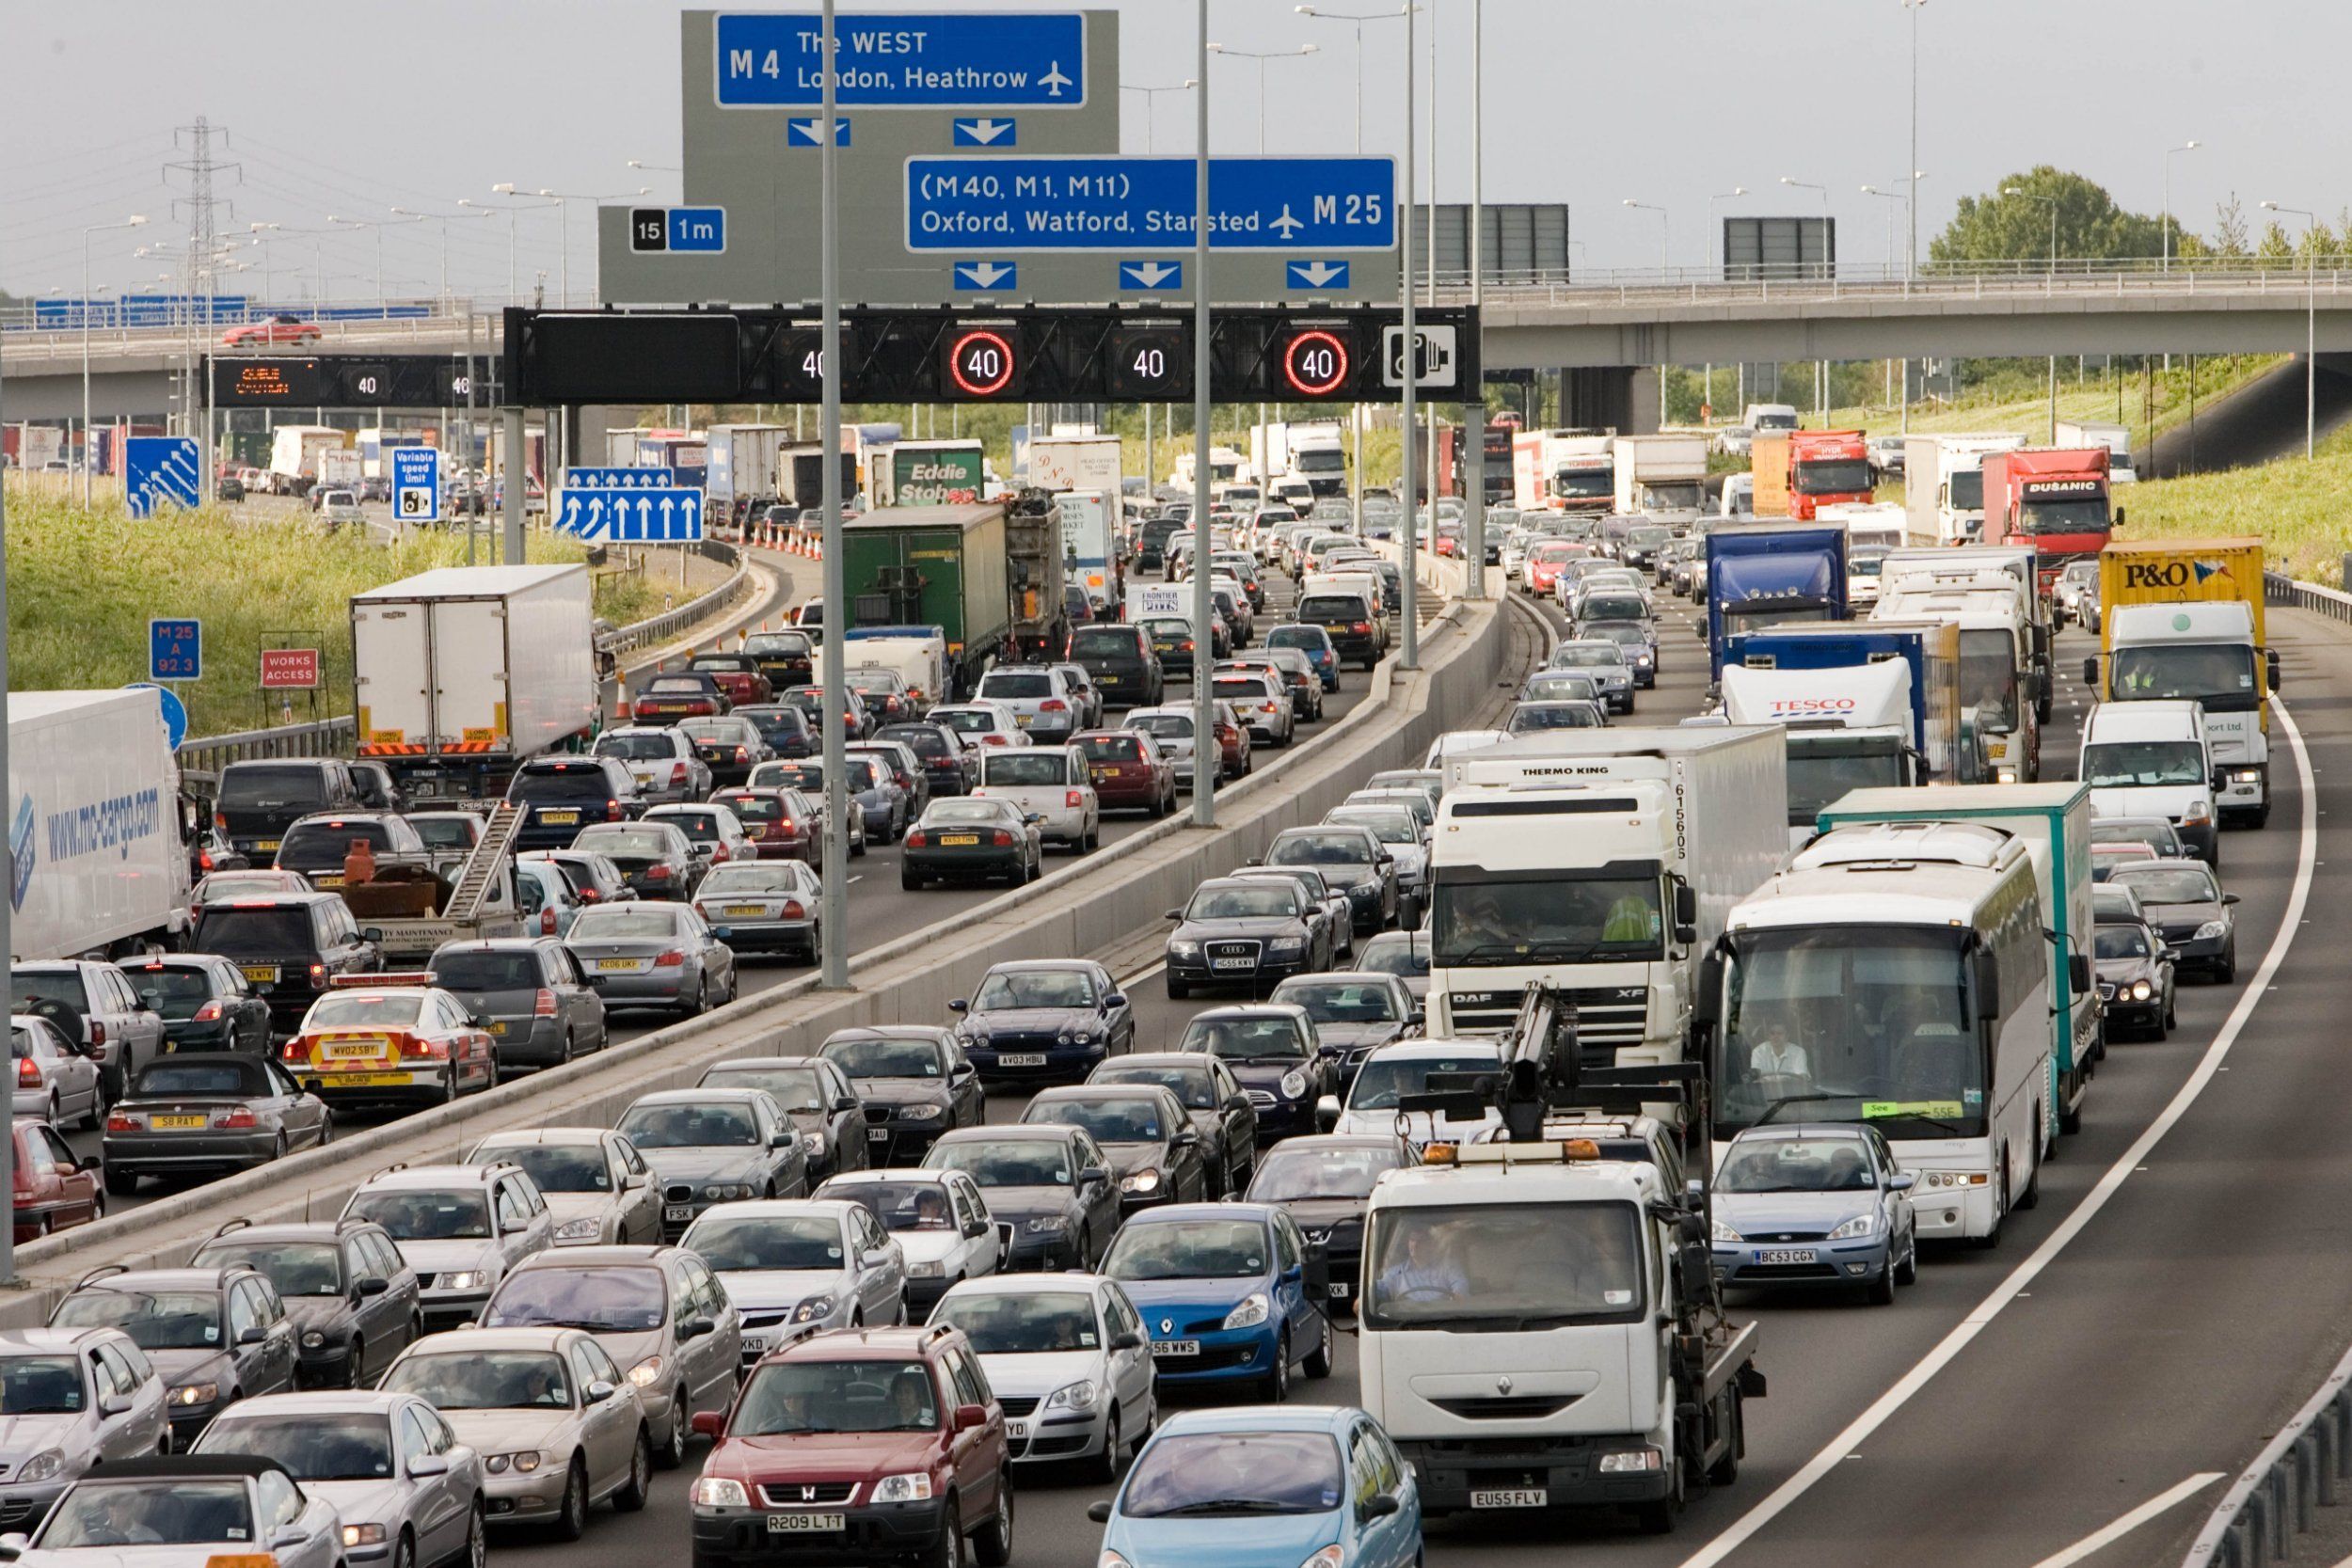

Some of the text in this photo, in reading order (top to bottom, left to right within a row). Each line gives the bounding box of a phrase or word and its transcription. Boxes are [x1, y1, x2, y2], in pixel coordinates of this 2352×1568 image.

[797, 31, 928, 54] The WEST
[905, 67, 1028, 89] Heathrow
[921, 210, 1015, 235] Oxford,
[1025, 210, 1136, 235] Watford,
[638, 222, 660, 240] 15
[967, 349, 999, 379] 40
[1133, 349, 1165, 379] 40
[1301, 349, 1333, 379] 40
[358, 377, 376, 394] 40
[452, 377, 469, 394] 40
[396, 451, 435, 463] Variable
[402, 463, 430, 474] speed
[911, 463, 967, 481] Eddie
[405, 472, 427, 483] limit
[899, 483, 977, 500] Stob
[2124, 562, 2189, 588] P&O
[170, 642, 181, 656] A
[158, 657, 194, 673] 92.3
[269, 656, 310, 667] WORKS
[266, 669, 312, 680] ACCESS
[1770, 698, 1855, 711] TESCO
[2227, 721, 2244, 732] Ltd.
[1576, 767, 1609, 775] KING
[47, 786, 160, 861] www.mc-cargo.com
[395, 928, 453, 937] MAINTENANCE
[256, 970, 273, 979] NTV
[1453, 993, 1492, 1004] DAF
[1616, 989, 1646, 998] XF
[333, 1044, 376, 1055] MV02 SBY
[1003, 1054, 1042, 1065] AV03 HBU
[176, 1117, 195, 1127] RAT
[669, 1208, 690, 1219] FSK
[1761, 1250, 1814, 1262] BC53 CGX
[740, 1338, 763, 1350] KKD
[1152, 1341, 1195, 1354] 56 WWS
[1476, 1491, 1541, 1506] EU55 FLV
[769, 1514, 843, 1529] R209 LTT
